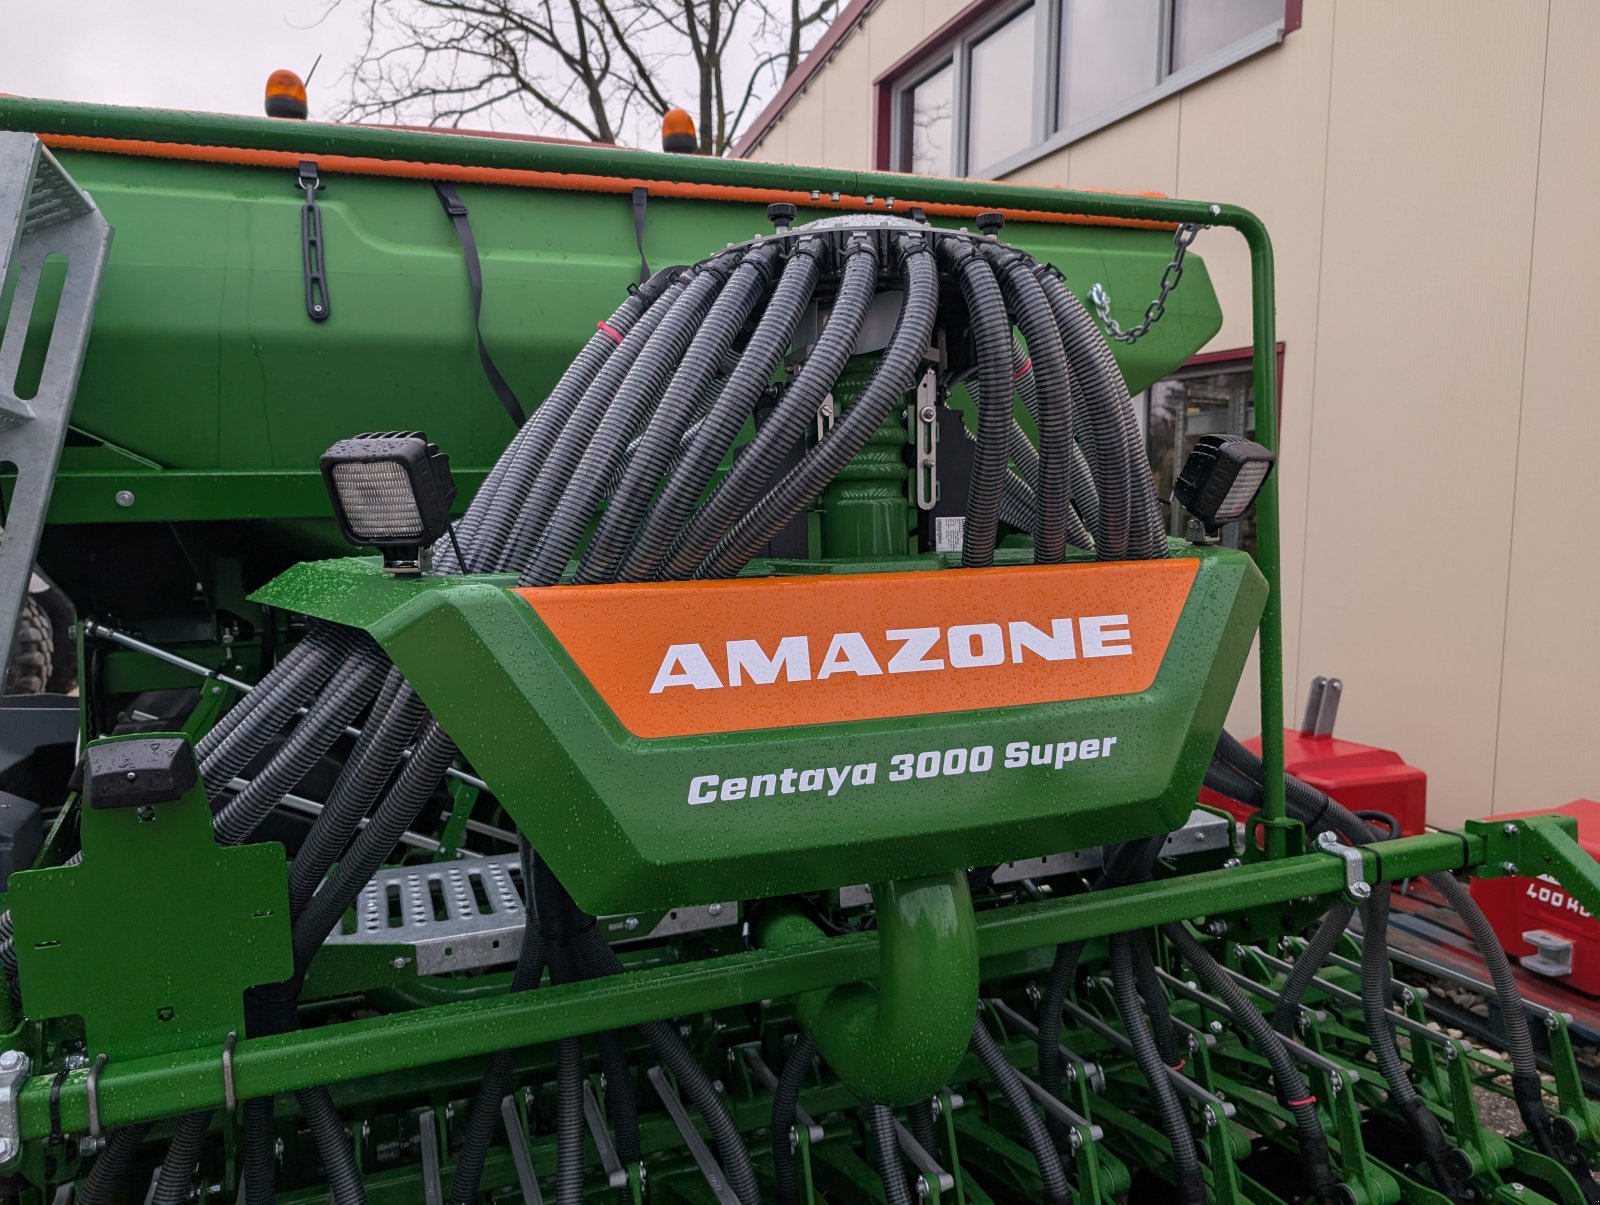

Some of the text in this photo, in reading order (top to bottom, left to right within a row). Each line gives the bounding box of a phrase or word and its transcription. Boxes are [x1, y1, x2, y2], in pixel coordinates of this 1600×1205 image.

[649, 614, 1133, 693] AMAZONE
[687, 736, 1118, 805] Centaya 3000 Super
[1526, 883, 1564, 907] 400
